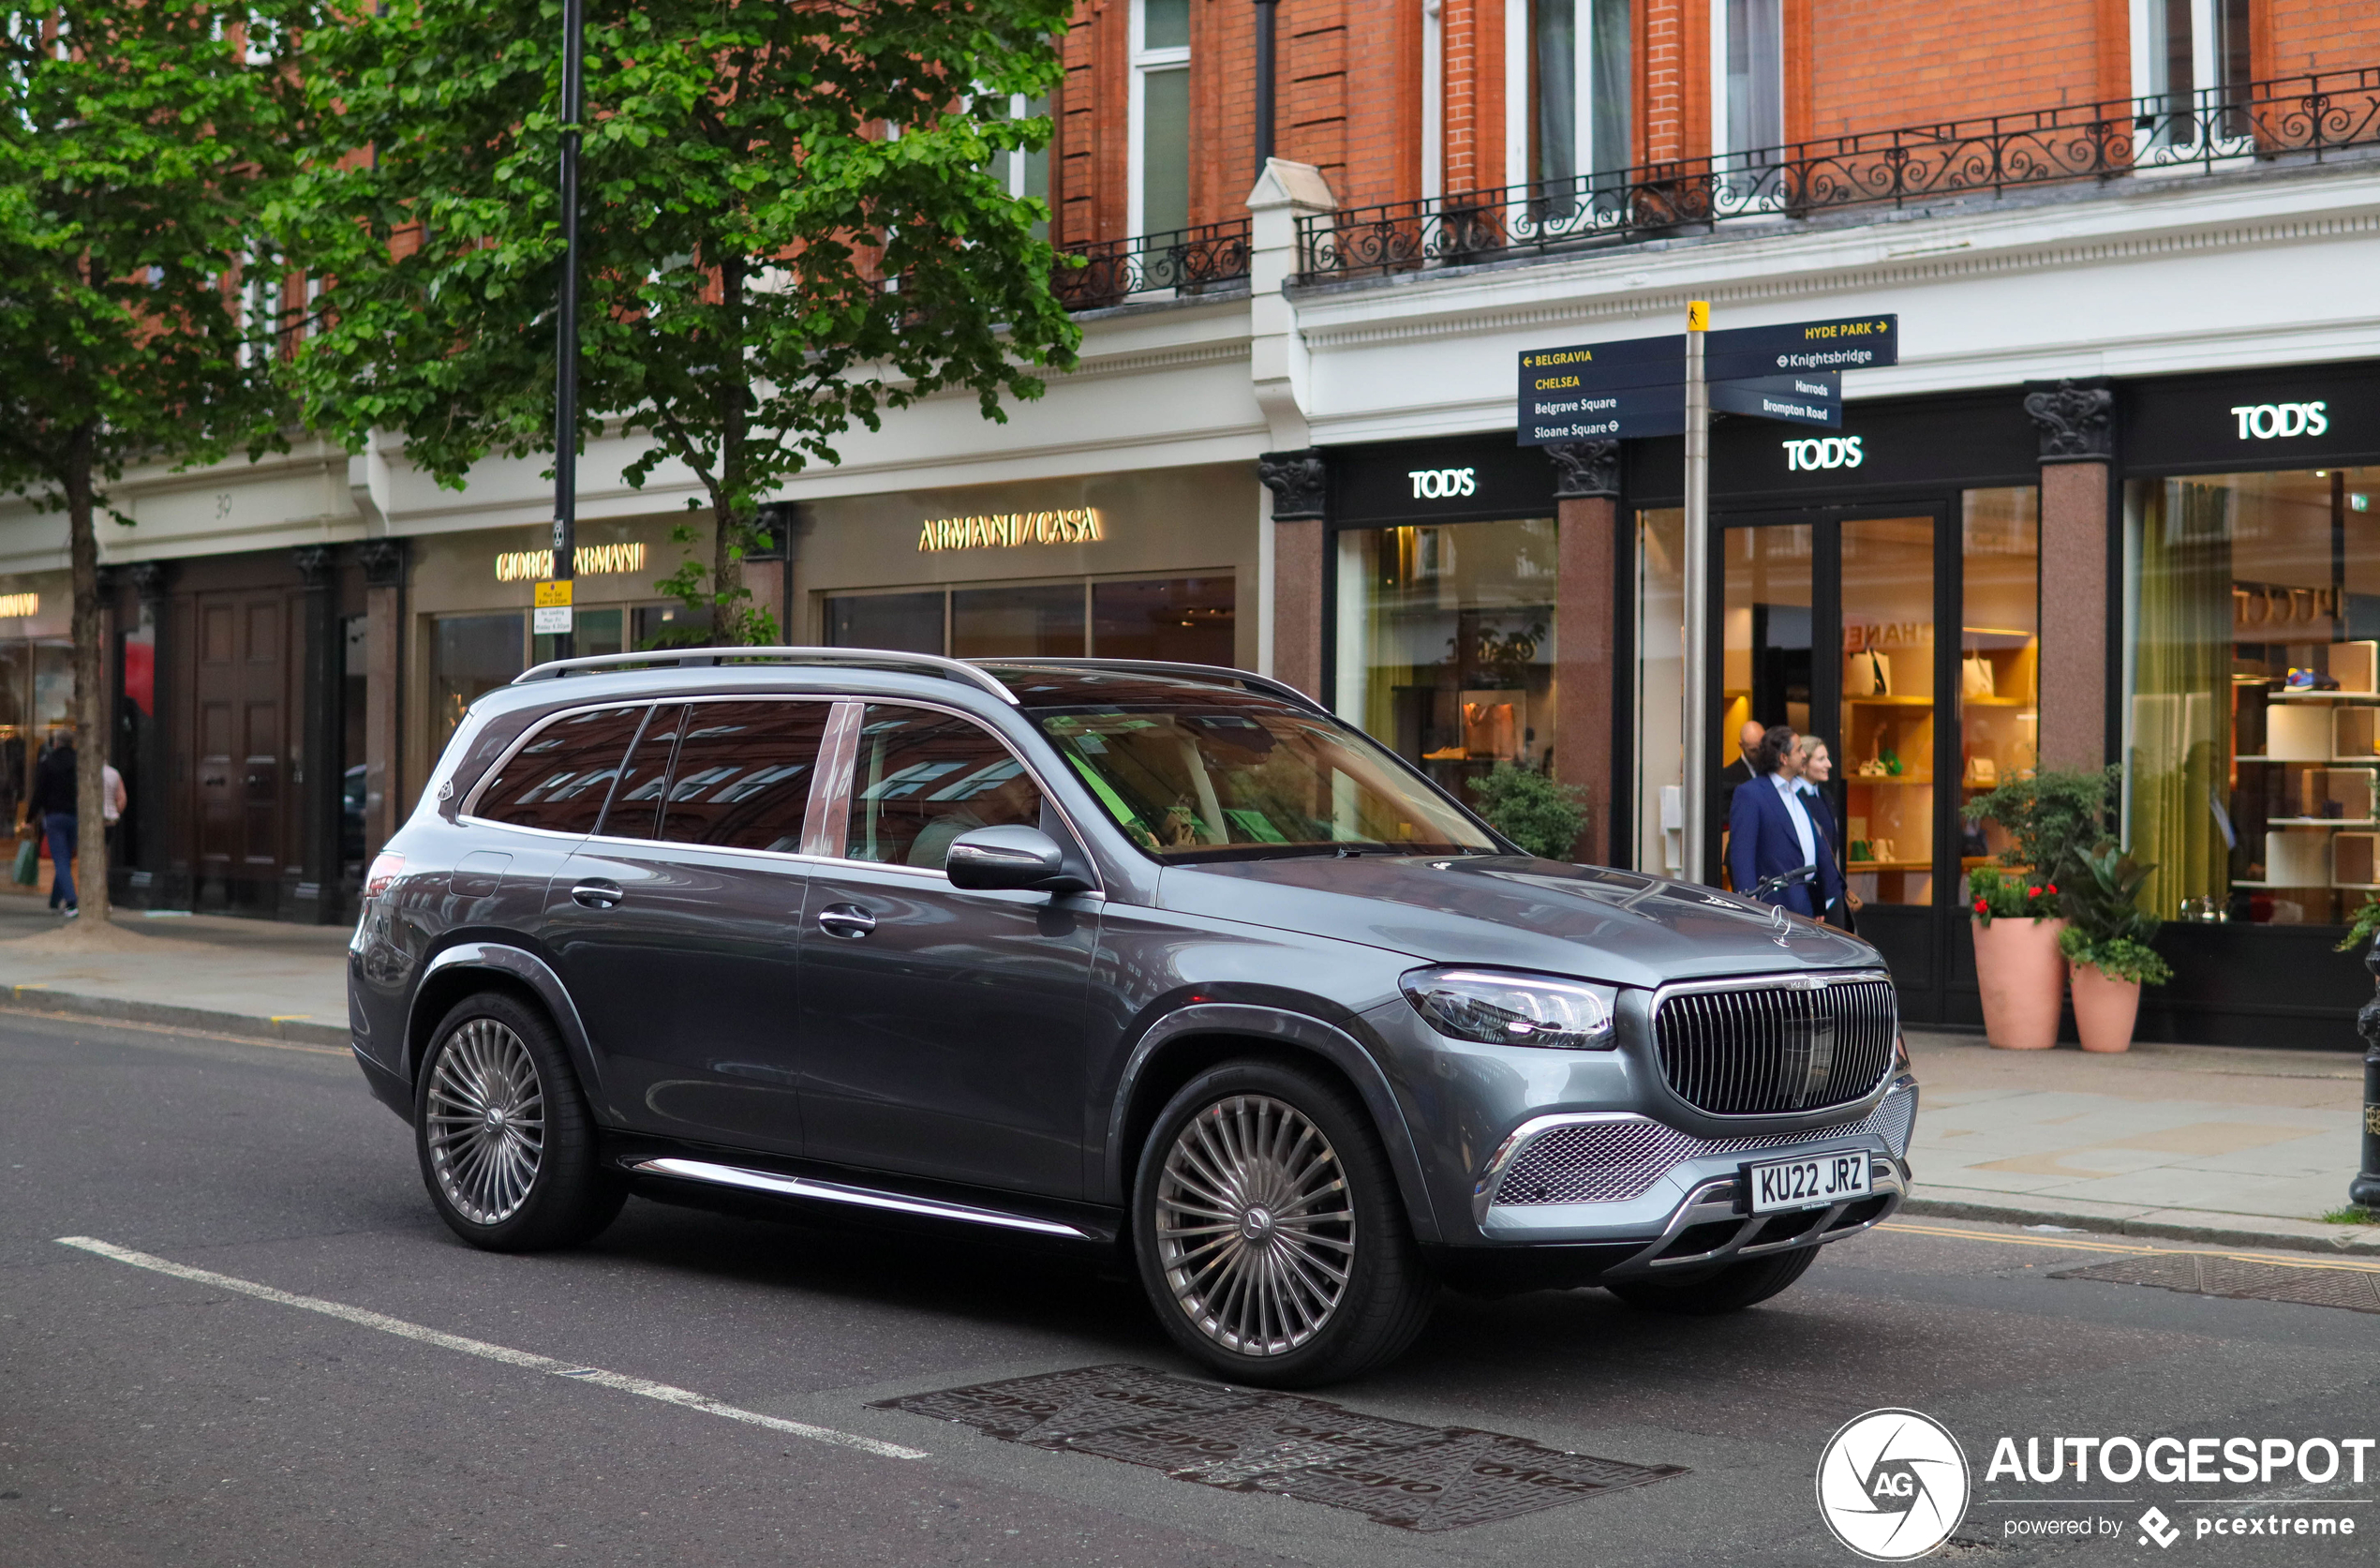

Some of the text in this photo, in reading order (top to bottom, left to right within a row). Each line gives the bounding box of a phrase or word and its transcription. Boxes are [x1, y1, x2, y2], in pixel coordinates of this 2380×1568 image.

[1805, 321, 1872, 340] HYDE PARK
[1535, 351, 1592, 367] BELGRAVIA
[1790, 349, 1872, 367] Knightsbridge
[1535, 376, 1580, 390] CHELSEA
[1795, 380, 1828, 396] Harrods
[1535, 397, 1616, 416] Belgrave Square
[1763, 399, 1827, 421] Brompton Road
[2231, 401, 2328, 440] TOD'S
[1534, 423, 1607, 439] Sloane Square
[1782, 436, 1864, 471] TOD'S
[1408, 468, 1476, 500] TOD'S
[496, 542, 645, 581] GIORGI ARMANI
[1762, 1157, 1862, 1203] KU22 JRZ
